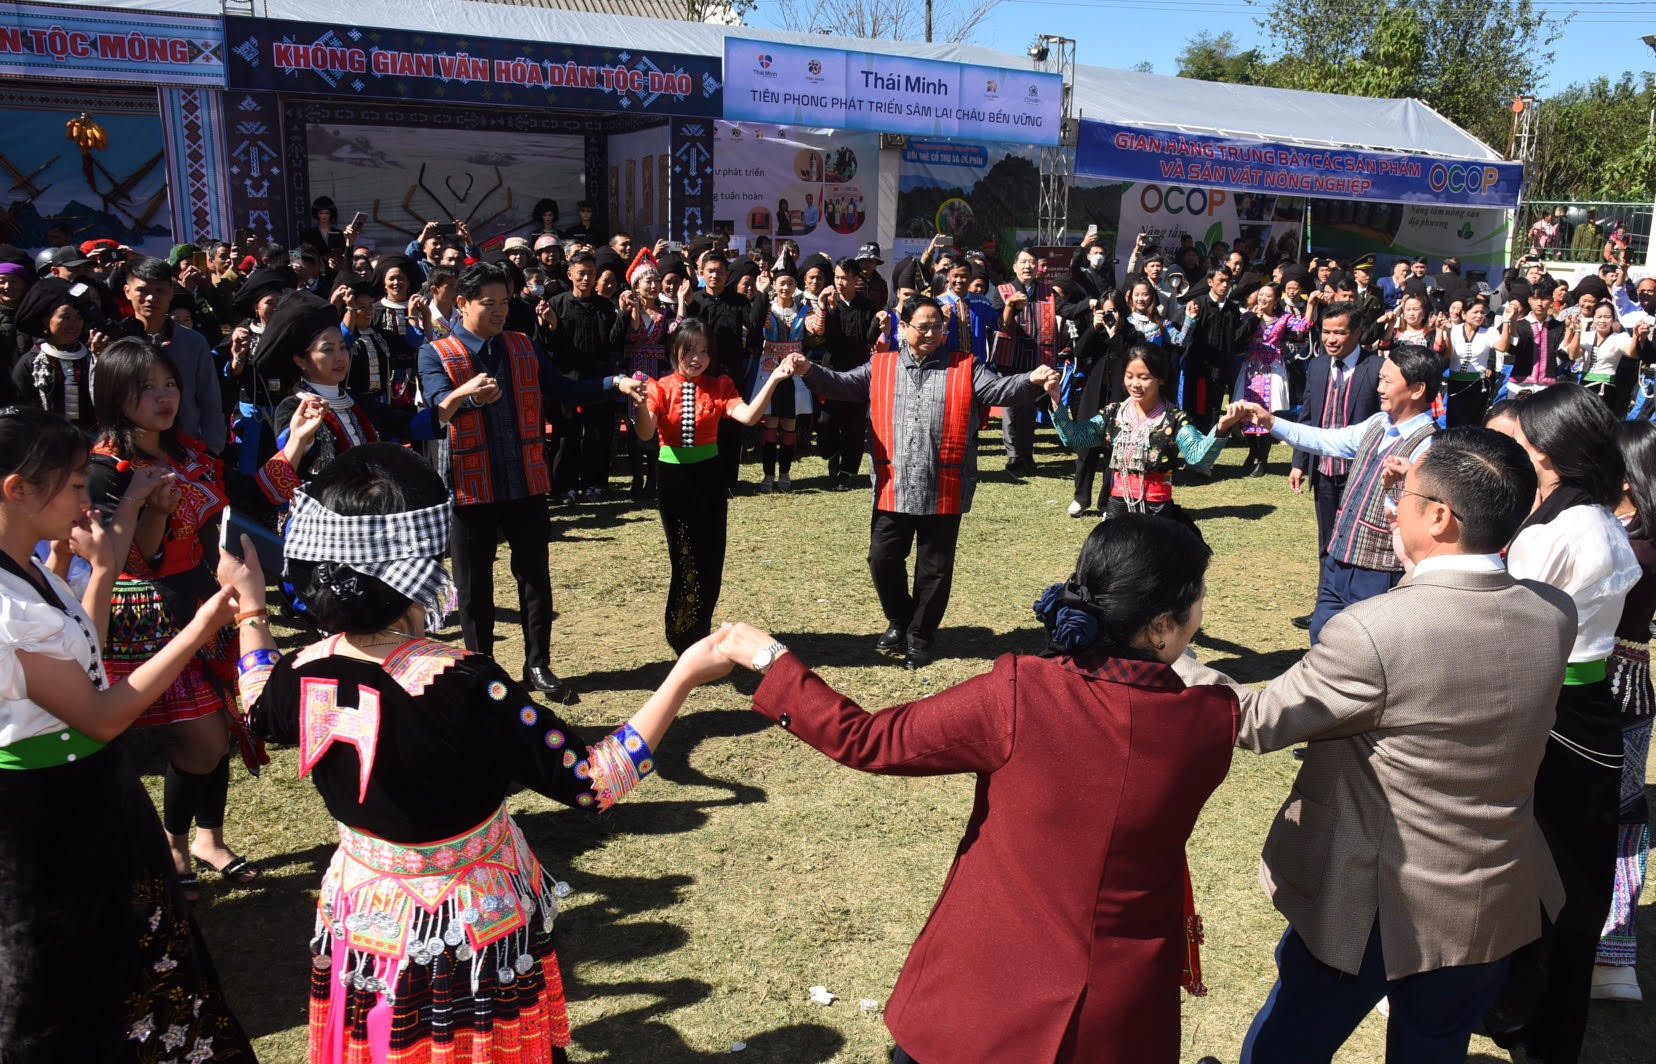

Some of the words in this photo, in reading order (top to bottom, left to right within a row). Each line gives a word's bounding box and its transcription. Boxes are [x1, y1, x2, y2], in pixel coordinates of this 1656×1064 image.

[28, 25, 90, 61] TỘC
[97, 30, 189, 64] MÔNG
[273, 41, 366, 73] KHÔNG
[372, 50, 433, 77] GIAN
[439, 53, 489, 82] VĂN
[494, 57, 543, 86] HÓA
[548, 61, 596, 88] DÂN
[601, 65, 643, 95] TỘC
[649, 71, 692, 96] DAO
[860, 70, 901, 91] Thái
[905, 74, 948, 96] Minh
[750, 88, 780, 104] TIÊN
[784, 93, 827, 108] PHONG
[831, 95, 864, 111] PHÁT
[867, 98, 903, 114] TRIỂN
[906, 102, 932, 118] SÂM
[935, 107, 952, 119] LAI
[955, 108, 985, 122] CHÂU
[988, 109, 1010, 124] BỀN
[1013, 112, 1043, 127] VỮNG
[1115, 132, 1162, 153] GIAN
[1165, 136, 1215, 158] HÀNG
[1216, 145, 1275, 164] TRƯNG
[1278, 150, 1310, 168] BÀY
[1312, 153, 1343, 171] CÁC
[1344, 156, 1377, 174] SẢN
[1378, 158, 1421, 177] PHẨM
[722, 167, 743, 178] phát
[745, 167, 765, 177] triển
[1160, 158, 1185, 179] VÀ
[1188, 162, 1226, 183] SẢN
[1229, 166, 1262, 191] VẬT
[1264, 170, 1311, 190] NÔNG
[1313, 176, 1371, 199] NGHIỆP
[1429, 163, 1499, 195] OCOP
[720, 191, 740, 200] tuần
[742, 191, 763, 201] hoàn
[1140, 184, 1226, 216] OCOP
